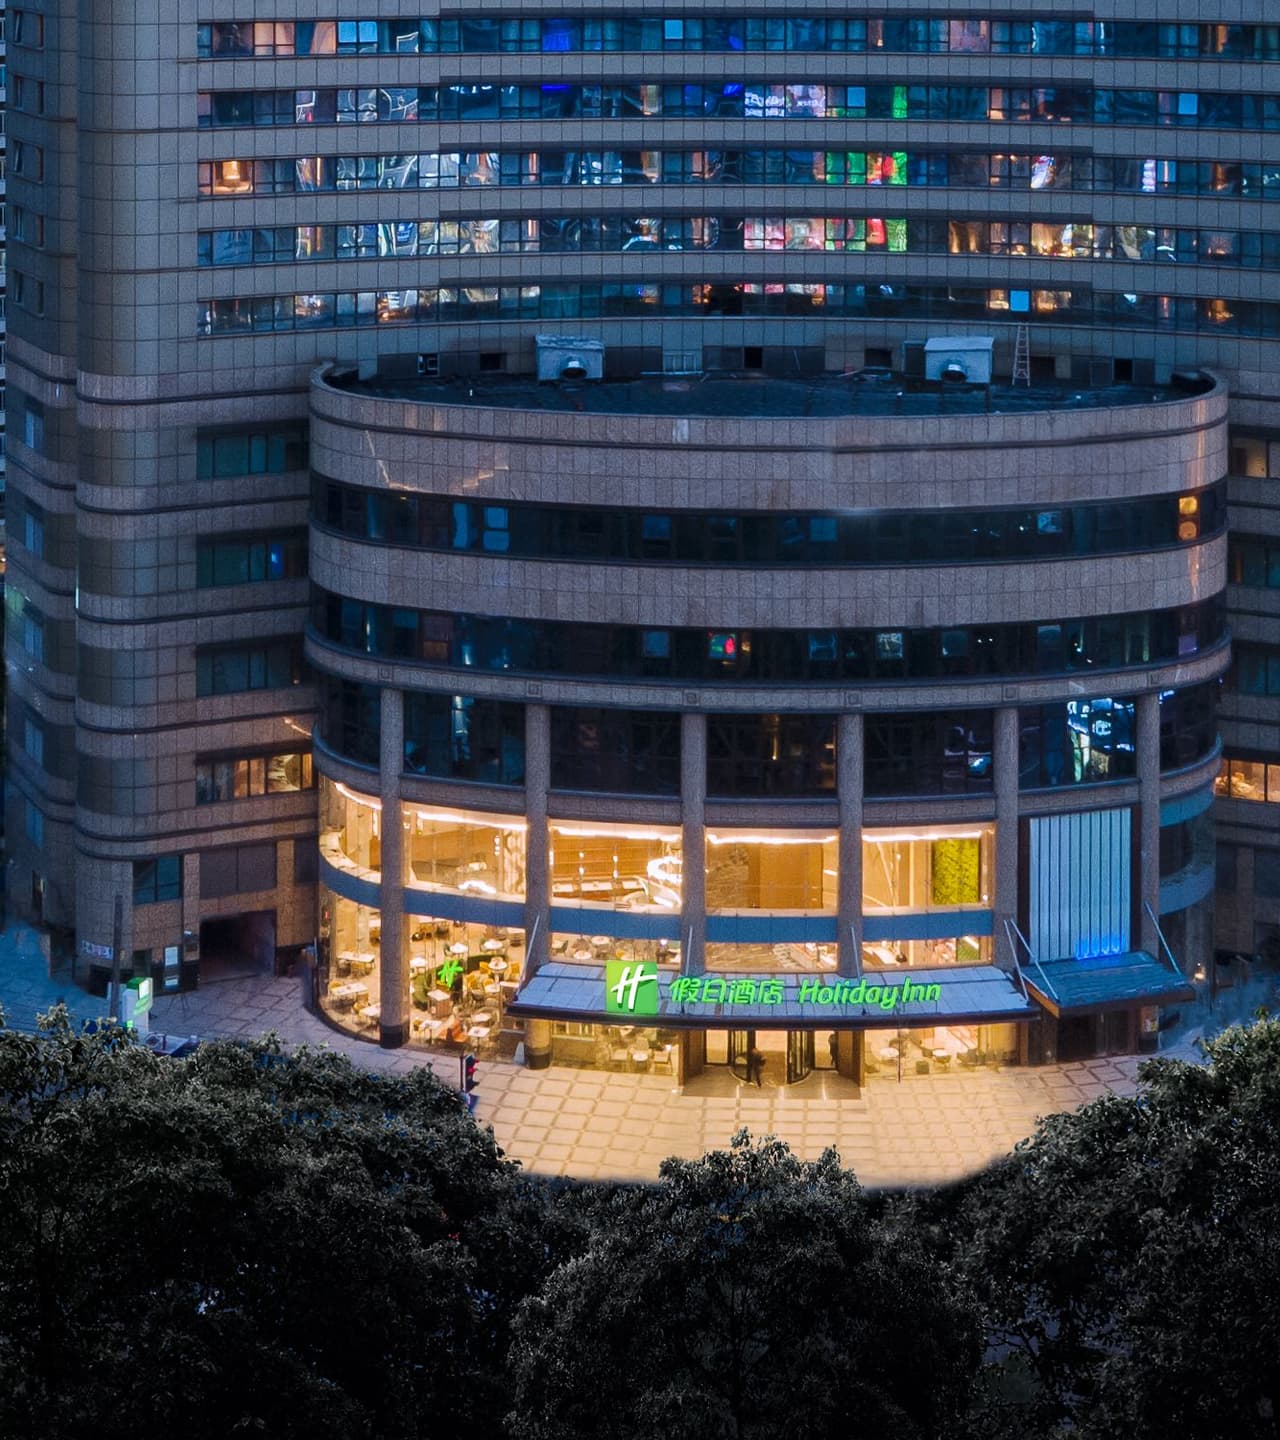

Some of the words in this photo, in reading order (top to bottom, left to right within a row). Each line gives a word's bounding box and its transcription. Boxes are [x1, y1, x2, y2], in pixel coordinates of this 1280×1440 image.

[669, 977, 785, 1005] 假日酒店
[799, 978, 899, 1009] Holiday
[902, 977, 941, 1002] Inn
